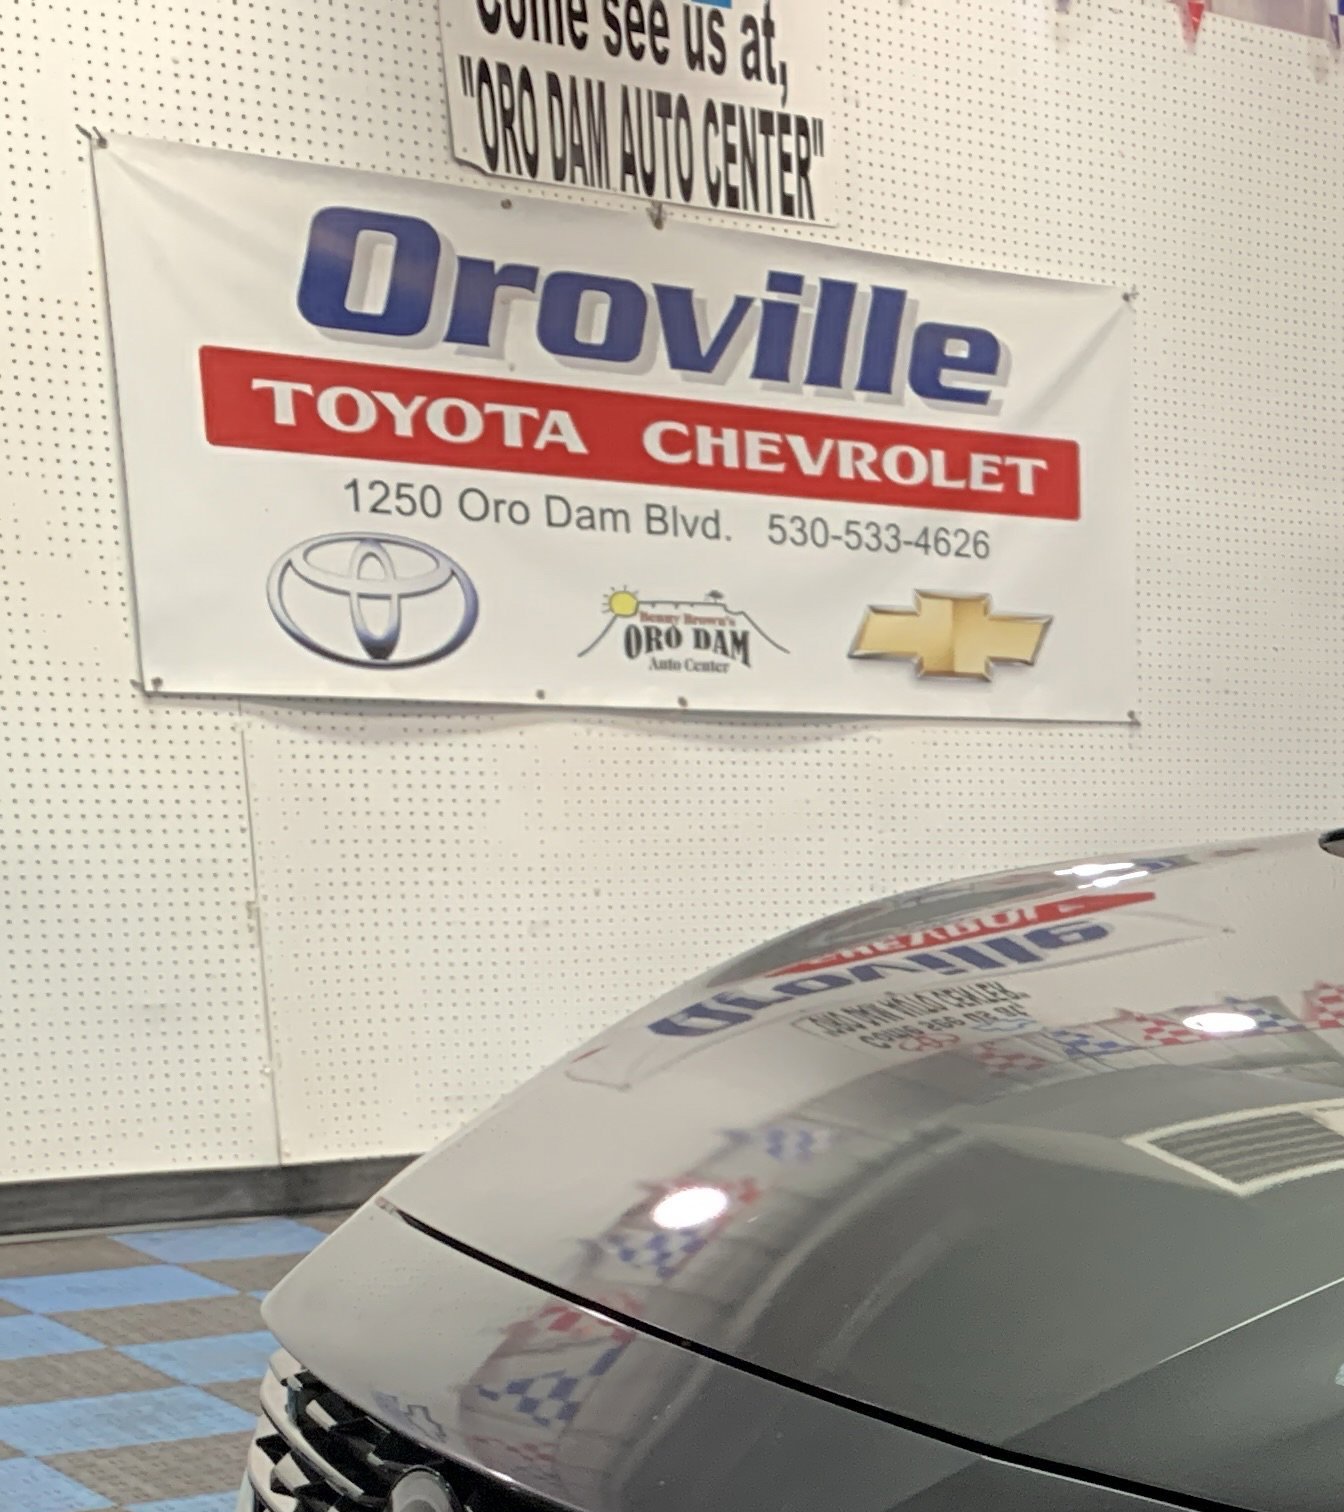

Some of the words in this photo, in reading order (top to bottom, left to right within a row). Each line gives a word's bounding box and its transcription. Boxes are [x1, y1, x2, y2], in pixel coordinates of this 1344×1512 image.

[602, 0, 671, 66] see
[682, 3, 728, 76] us
[739, 0, 789, 108] at,
[458, 54, 540, 180] "ORO
[545, 70, 613, 190] DAM
[618, 84, 694, 203] AUTO
[703, 97, 825, 221] CENTER"
[297, 206, 1004, 407] Oroville
[252, 378, 589, 454] TOYOTA
[642, 420, 1048, 496] CHEVROLET
[343, 478, 442, 519] 1250
[457, 487, 530, 526] Oro
[545, 493, 632, 534] Dam
[645, 503, 733, 542] Blvd.
[767, 513, 991, 560] 530-533-4626
[623, 623, 683, 660] ORO
[692, 627, 752, 668] DAM
[648, 656, 682, 672] Auto
[684, 658, 731, 674] Center
